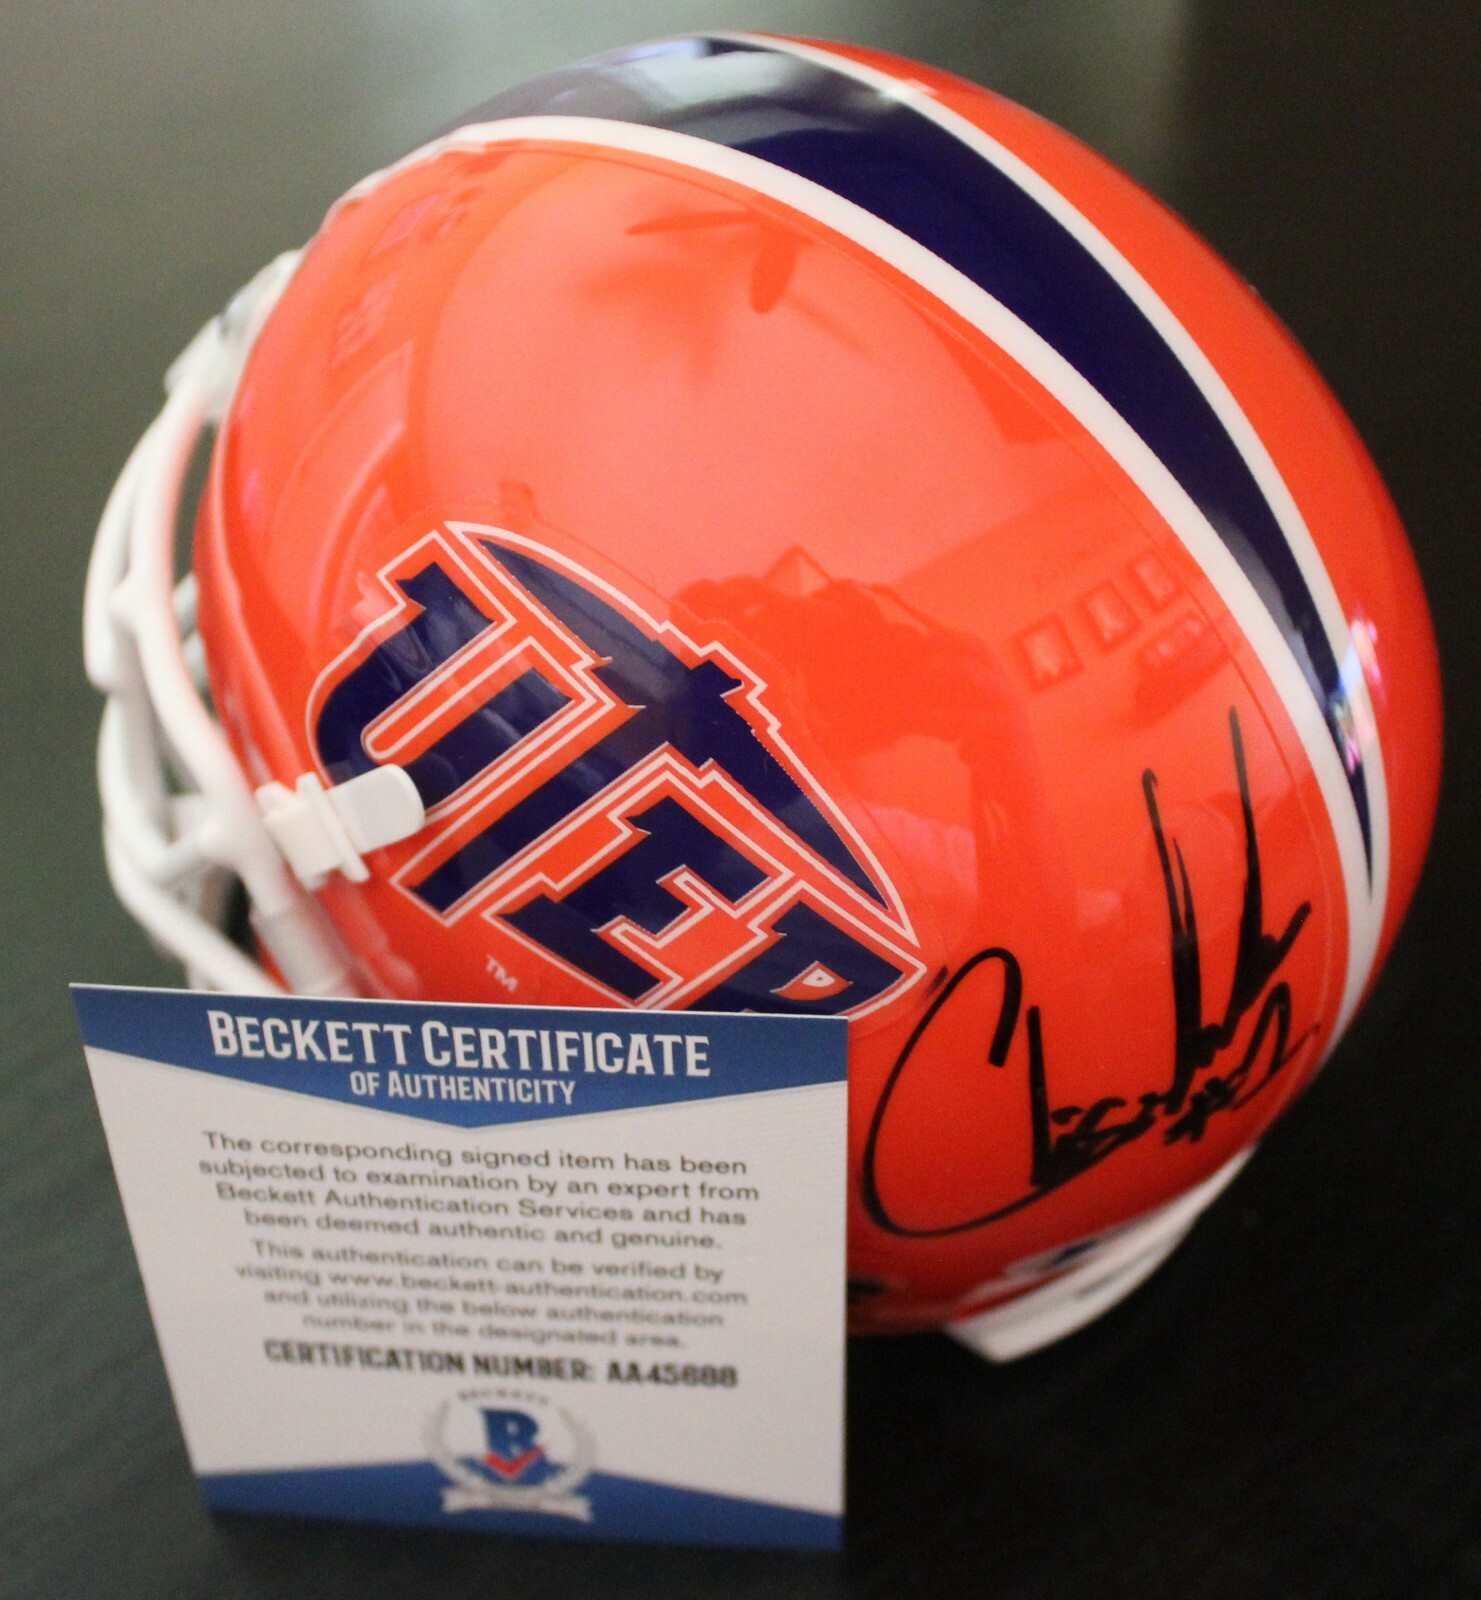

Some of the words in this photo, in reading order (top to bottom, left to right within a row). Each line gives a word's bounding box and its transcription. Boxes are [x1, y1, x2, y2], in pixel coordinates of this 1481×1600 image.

[207, 1009, 412, 1065] BECKETT
[421, 1020, 712, 1077] CERTIFICATE
[350, 1071, 380, 1096] OF
[387, 1069, 577, 1105] AUTHENTICITY
[202, 1130, 252, 1151] The
[260, 1138, 451, 1168] corresponding
[461, 1146, 550, 1168] signed
[559, 1149, 614, 1170] item
[624, 1153, 671, 1173] has
[680, 1154, 748, 1176] been
[199, 1158, 324, 1181] subjected
[333, 1165, 357, 1183] to
[366, 1168, 519, 1192] examination
[528, 1174, 558, 1197] by
[567, 1179, 598, 1196] an
[607, 1179, 690, 1201] expert
[700, 1181, 760, 1201] from
[215, 1180, 317, 1206] Beckett
[325, 1189, 509, 1216] Authentication
[518, 1198, 633, 1221] Services
[643, 1206, 691, 1225] and
[701, 1206, 747, 1226] has
[244, 1208, 307, 1227] been
[316, 1212, 419, 1236] deemed
[428, 1219, 546, 1243] authentic
[554, 1226, 602, 1245] and
[611, 1229, 722, 1250] genuine.
[254, 1238, 303, 1259] This
[311, 1247, 489, 1271] authentication
[496, 1257, 543, 1273] can
[551, 1256, 583, 1275] be
[592, 1260, 686, 1280] verified
[695, 1263, 724, 1285] by
[263, 1338, 466, 1374] CERTIFICATION
